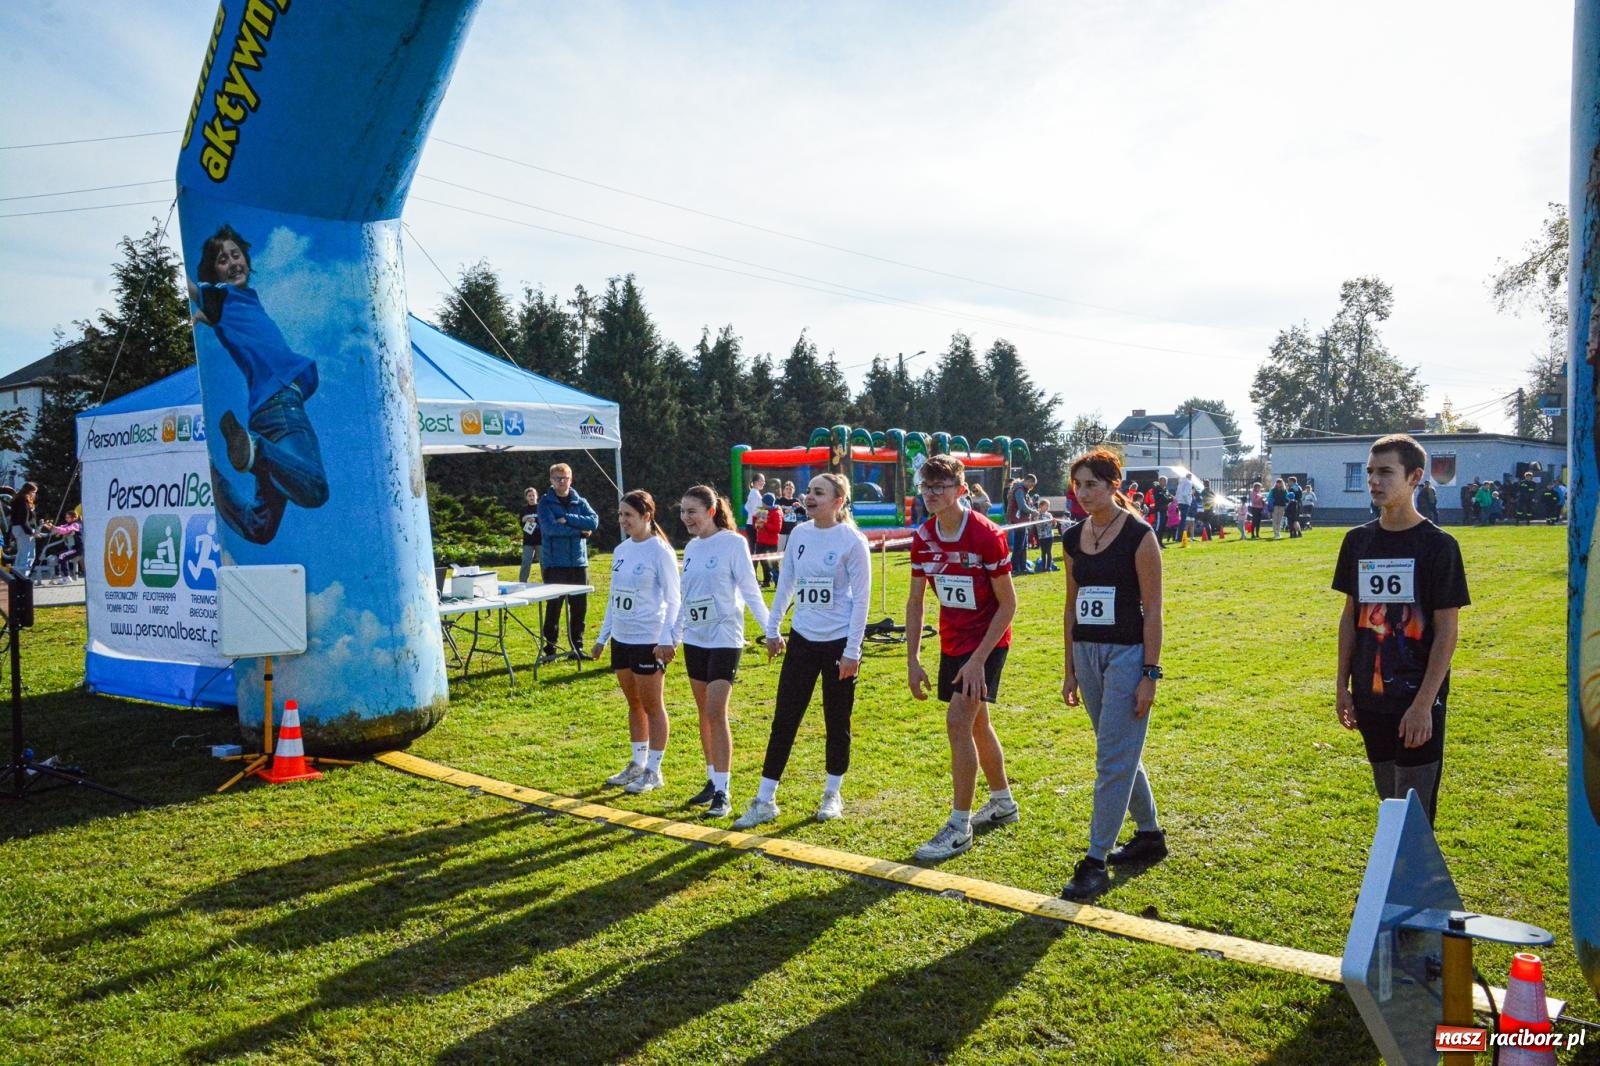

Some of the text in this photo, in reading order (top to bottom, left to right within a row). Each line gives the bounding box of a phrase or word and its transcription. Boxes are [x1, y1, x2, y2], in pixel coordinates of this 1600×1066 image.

[200, 0, 292, 184] aktywn
[87, 424, 158, 449] PersonalBest
[107, 472, 215, 511] PersonalBe
[797, 544, 806, 560] 9
[943, 586, 967, 603] 76
[1370, 574, 1402, 595] 96
[797, 588, 831, 604] 109
[690, 606, 708, 622] 97
[1080, 599, 1104, 618] 98
[110, 621, 218, 648] www.personalbest.p
